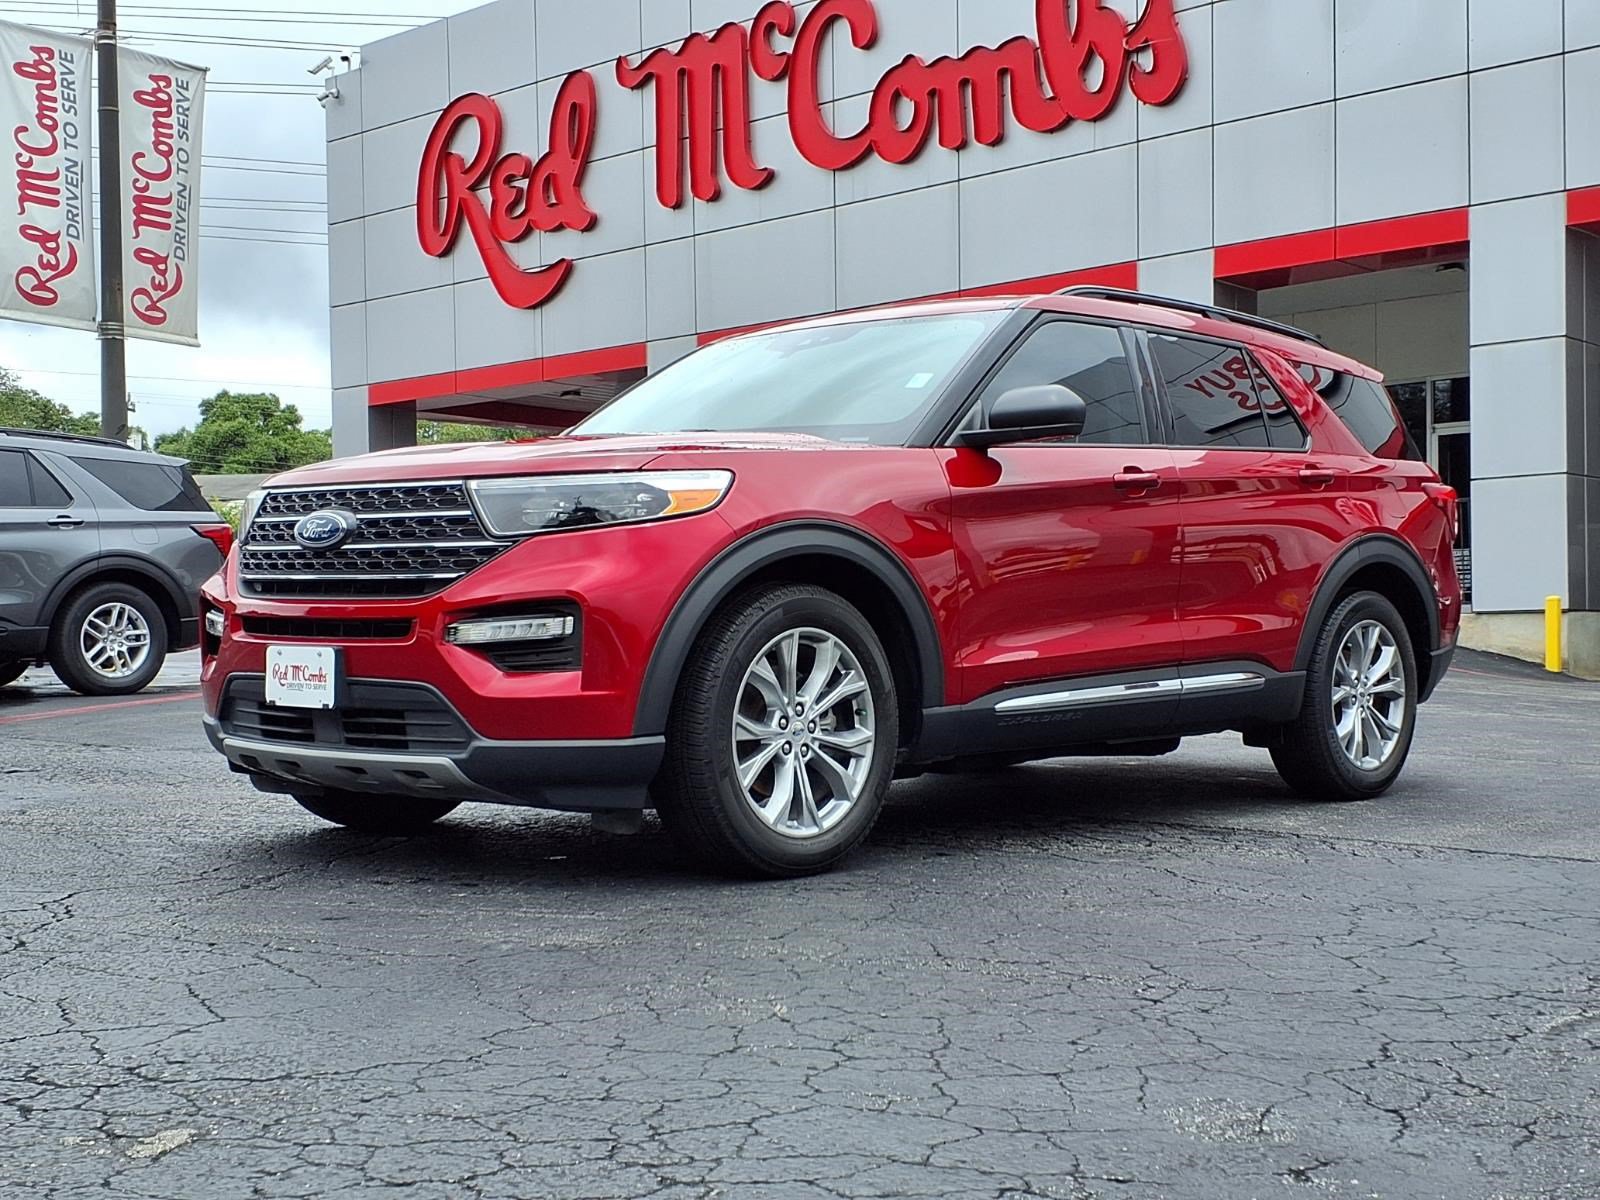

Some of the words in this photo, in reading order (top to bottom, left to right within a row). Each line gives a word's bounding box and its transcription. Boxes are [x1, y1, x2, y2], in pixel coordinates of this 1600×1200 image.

[58, 49, 77, 117] SERVE
[175, 77, 190, 143] SERVE
[12, 45, 61, 216] McCombs
[62, 121, 79, 152] TO
[131, 73, 174, 240] McCombs
[176, 148, 190, 177] TO
[417, 70, 598, 309] Red
[615, 0, 1190, 210] McCombs
[64, 157, 81, 241] DRIVEN
[173, 181, 188, 262] DRIVEN
[15, 223, 78, 308] Red
[131, 247, 183, 326] Red
[302, 519, 333, 539] Ford
[272, 663, 289, 687] Red
[289, 664, 328, 683] McCombs
[312, 683, 327, 691] SERVE
